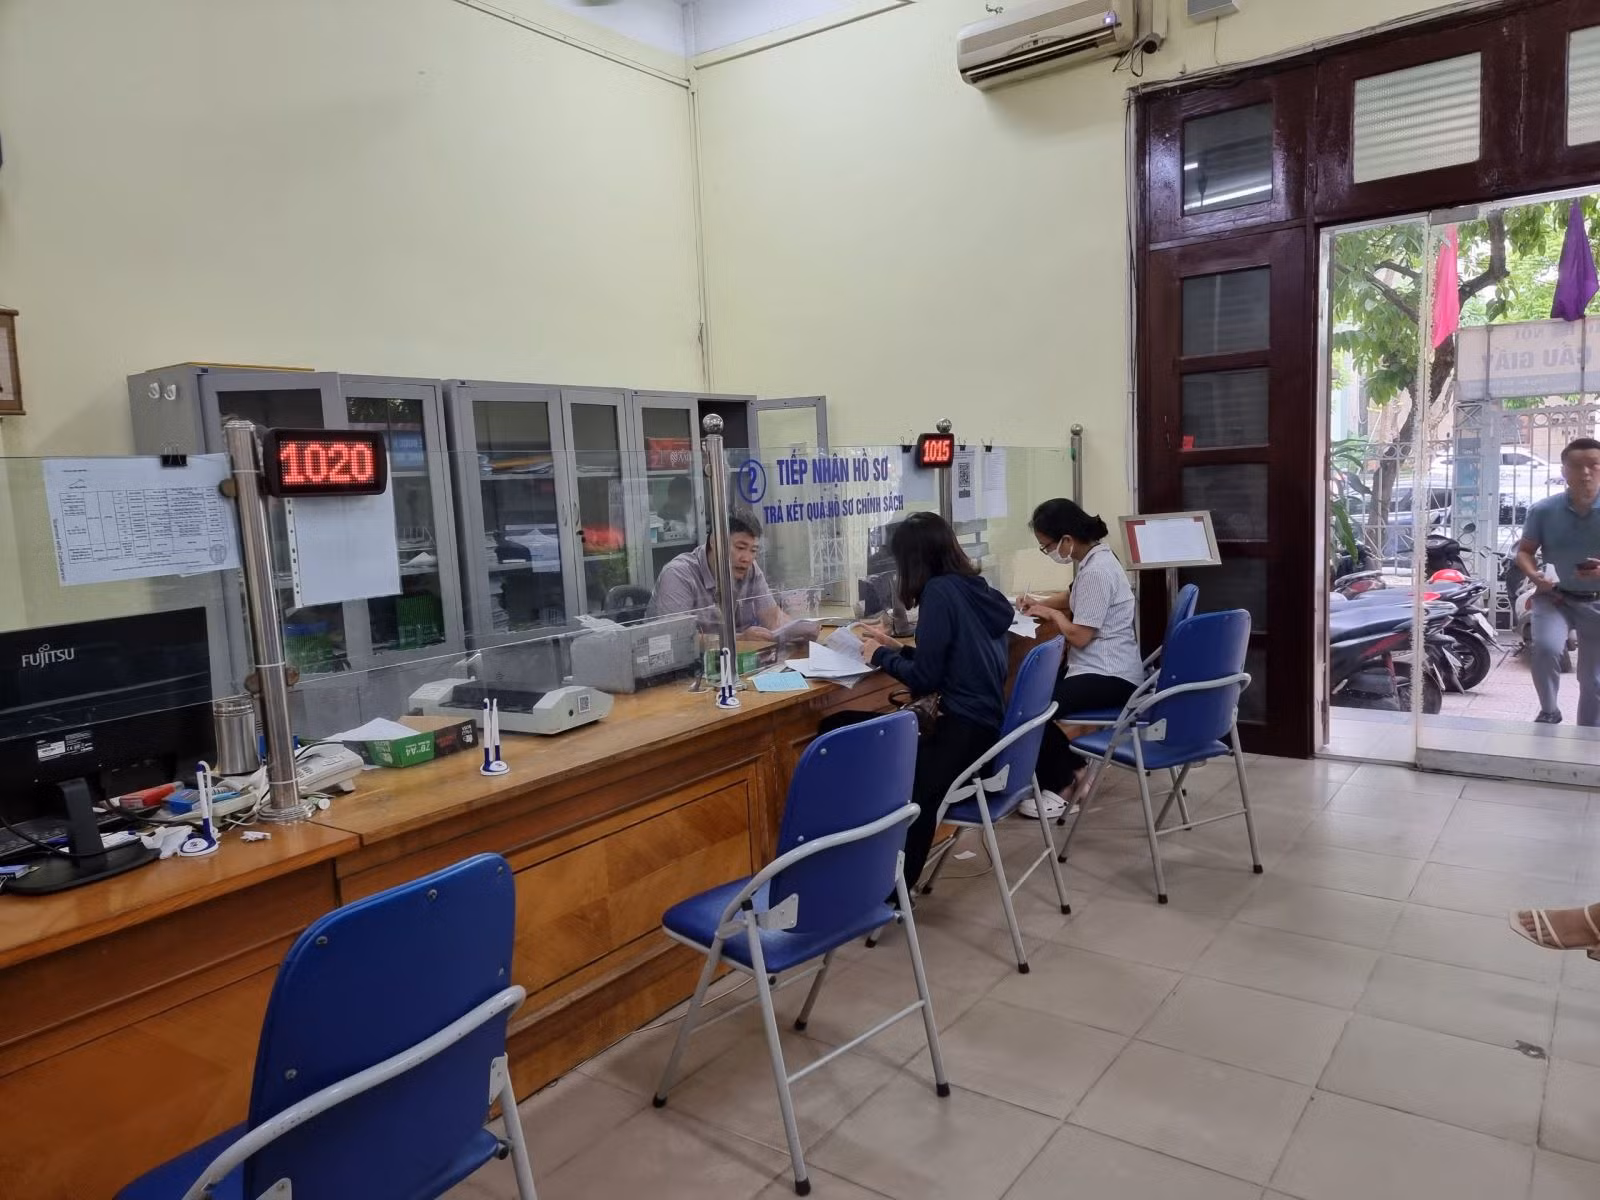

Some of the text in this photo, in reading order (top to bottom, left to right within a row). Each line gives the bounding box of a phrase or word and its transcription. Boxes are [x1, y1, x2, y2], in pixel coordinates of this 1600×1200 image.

[280, 442, 373, 483] 1020
[923, 439, 951, 462] 1015
[747, 467, 758, 494] 2
[776, 448, 889, 488] TIẾP NHẬN HỒ SƠ
[763, 491, 904, 525] TRẢ KẾT QUẢ HỒ SƠ CHÍNH SÁCH
[22, 645, 74, 668] FUJITSU
